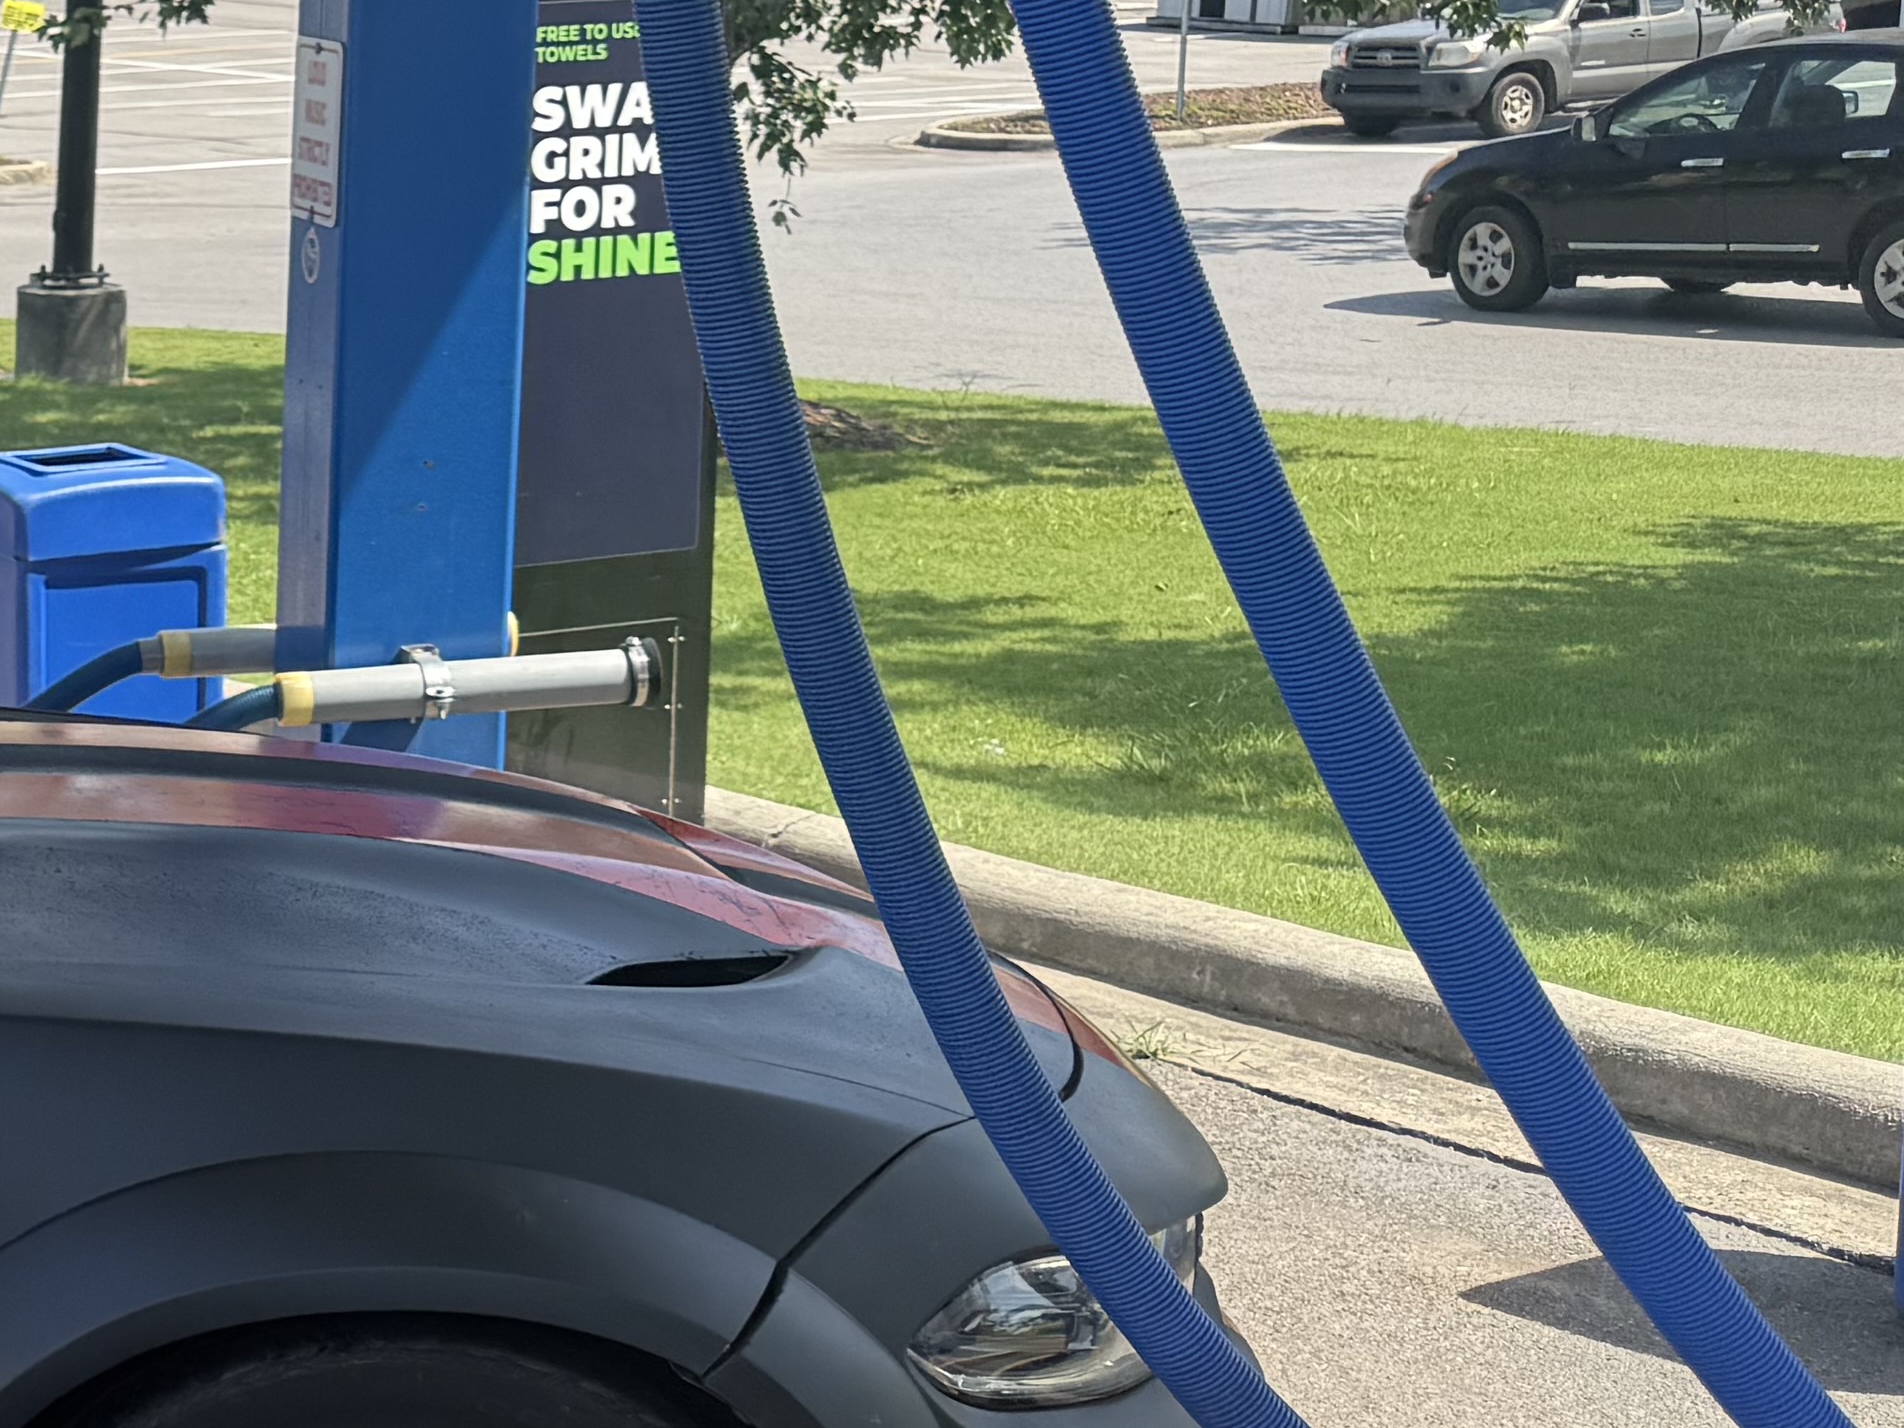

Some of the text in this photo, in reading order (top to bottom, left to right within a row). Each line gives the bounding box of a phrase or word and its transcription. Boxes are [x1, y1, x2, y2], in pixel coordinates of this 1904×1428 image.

[534, 43, 609, 63] TOWELS
[536, 24, 581, 43] FREE
[583, 23, 609, 40] TO
[531, 81, 655, 132] SWA
[531, 132, 663, 183] GRIM
[529, 183, 636, 234] FOR
[527, 230, 682, 285] SHINE
